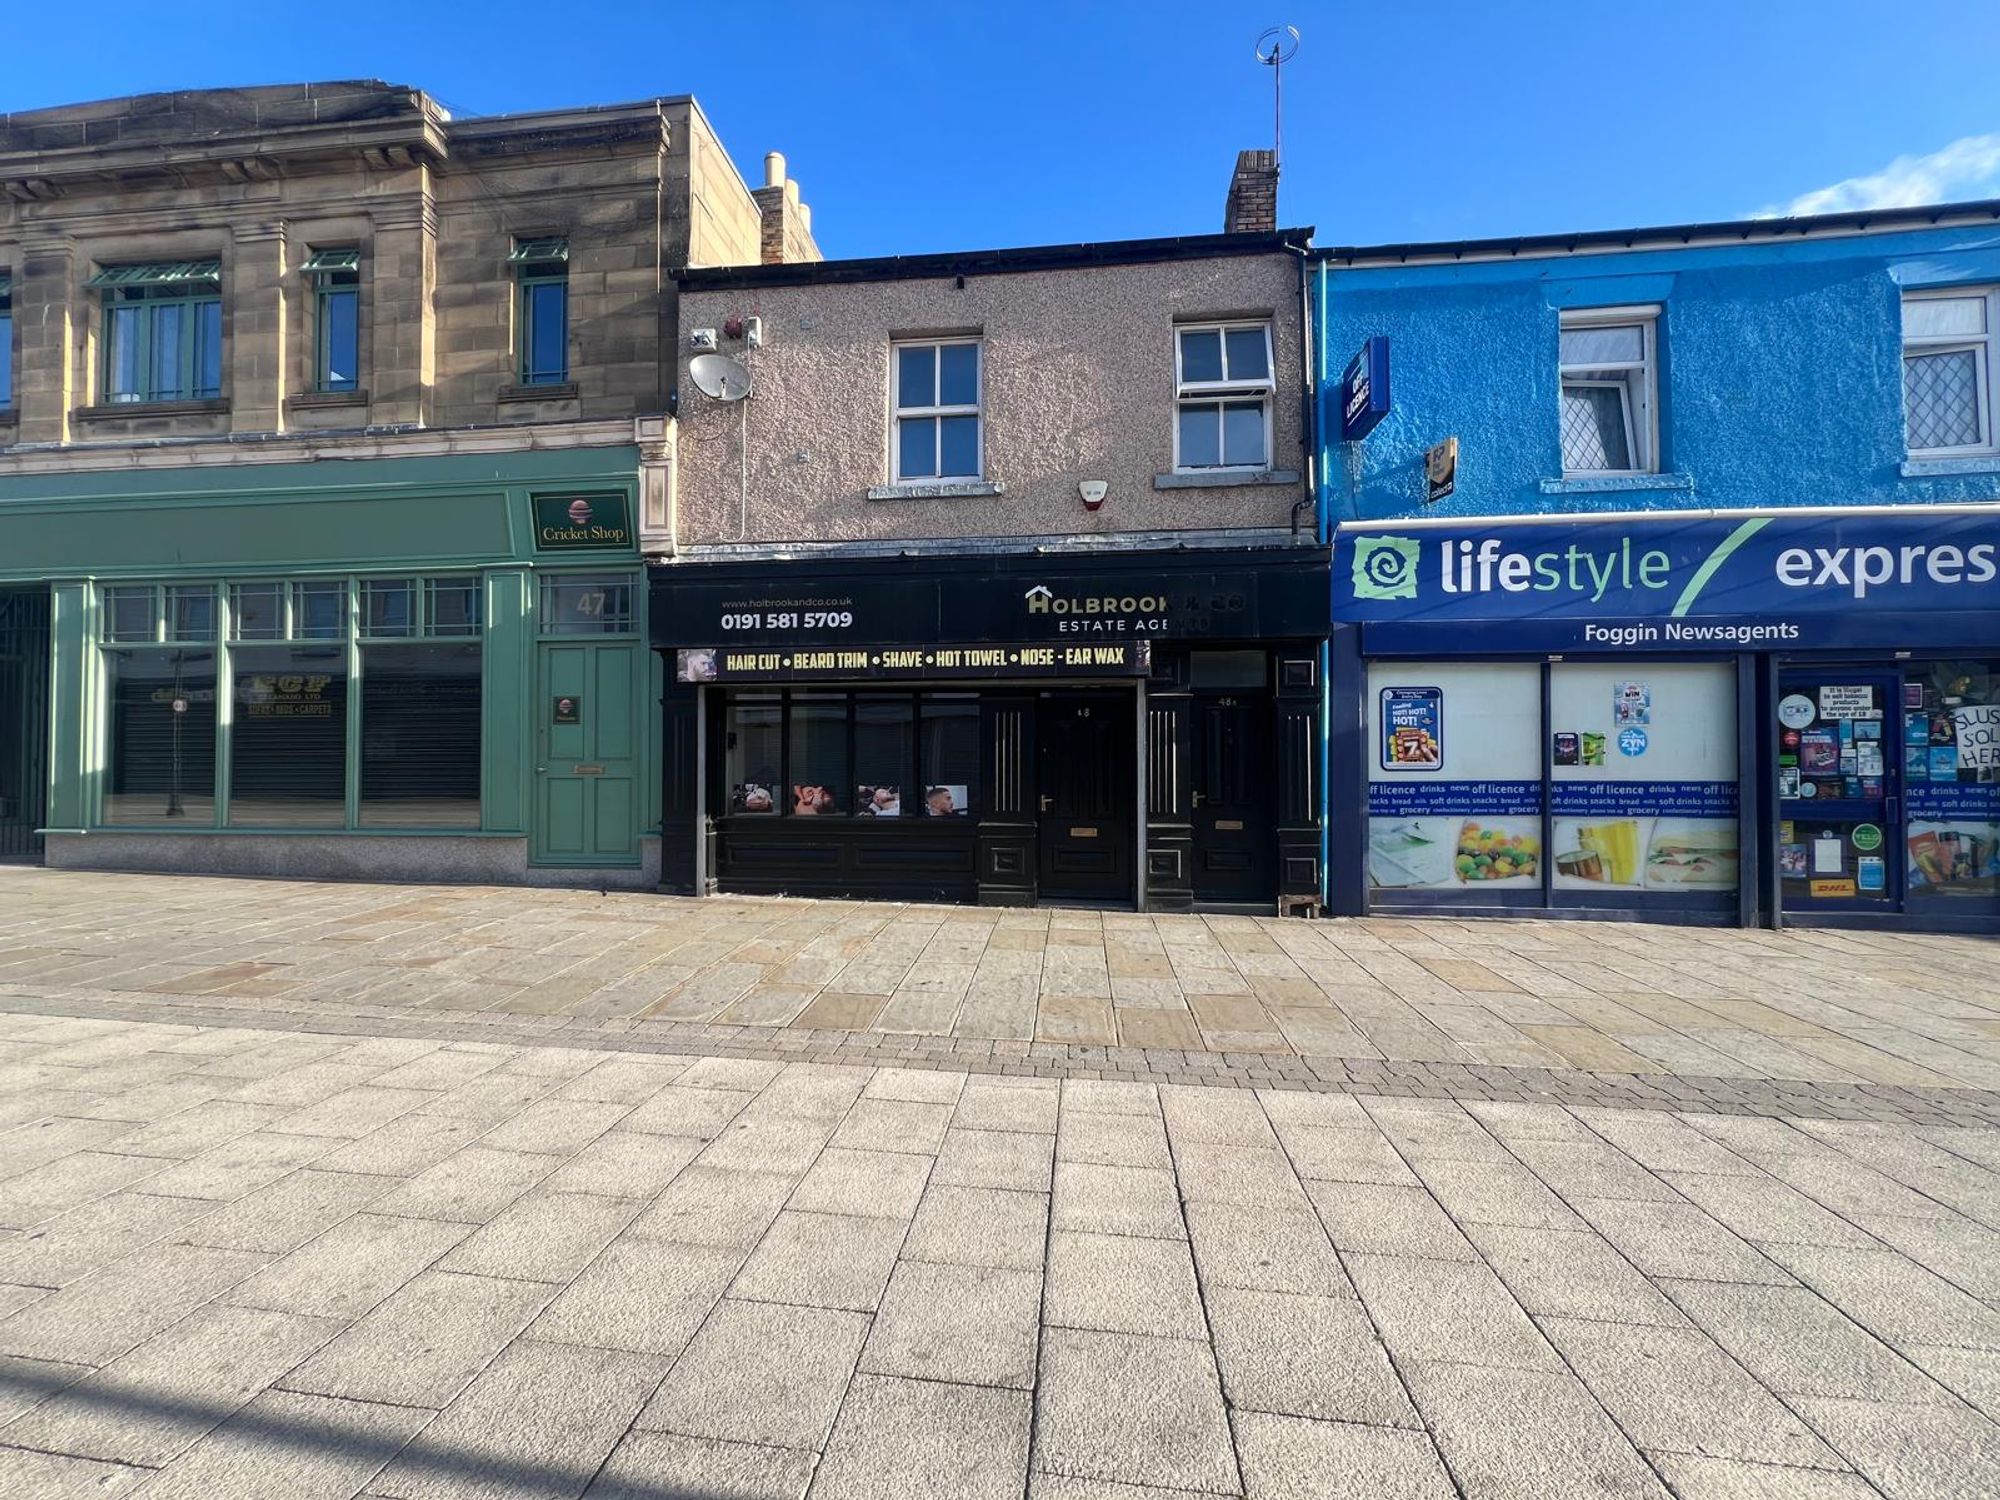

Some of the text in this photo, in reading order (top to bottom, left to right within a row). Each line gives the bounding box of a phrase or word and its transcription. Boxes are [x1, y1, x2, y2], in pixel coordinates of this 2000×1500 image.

[543, 526, 624, 542] Cricket Shop
[1441, 537, 1671, 602] lifestyle
[576, 593, 606, 615] 47
[721, 597, 853, 609] www.holbrookandco.co.uk
[721, 612, 853, 630] 0191 581 5709
[1059, 620, 1127, 632] ESTATE
[1585, 622, 1799, 645] Foggin Newsagents
[726, 655, 756, 671] HAIR
[759, 654, 781, 671] CUT
[793, 653, 835, 669] BEARD
[837, 652, 868, 668] TRIM
[882, 651, 923, 668] SHAVE
[936, 650, 963, 667] HOT
[964, 650, 1008, 667] TOWEL
[1020, 649, 1054, 666] NOSE
[1066, 648, 1092, 665] EAR
[1094, 647, 1125, 665] WAX
[1393, 716, 1417, 726] HOT!
[1621, 739, 1645, 748] ZYN
[1380, 785, 1416, 794] licence
[1420, 785, 1446, 793] drinks
[1472, 784, 1486, 794] off
[1488, 784, 1525, 794] licence
[1589, 785, 1604, 795] off
[1606, 785, 1644, 795] licence
[1649, 785, 1676, 793] drinks
[1704, 785, 1719, 795] off
[1930, 787, 1960, 795] drinks
[1430, 796, 1445, 806] soft
[1446, 796, 1470, 805] drinks
[1564, 796, 1588, 805] drinks
[1590, 797, 1616, 805] snacks
[1619, 797, 1640, 805] bread
[1659, 796, 1674, 806] soft
[1676, 796, 1701, 805] drinks
[1400, 806, 1431, 815] grocery
[1508, 806, 1540, 815] grocery
[1627, 807, 1660, 815] grocery
